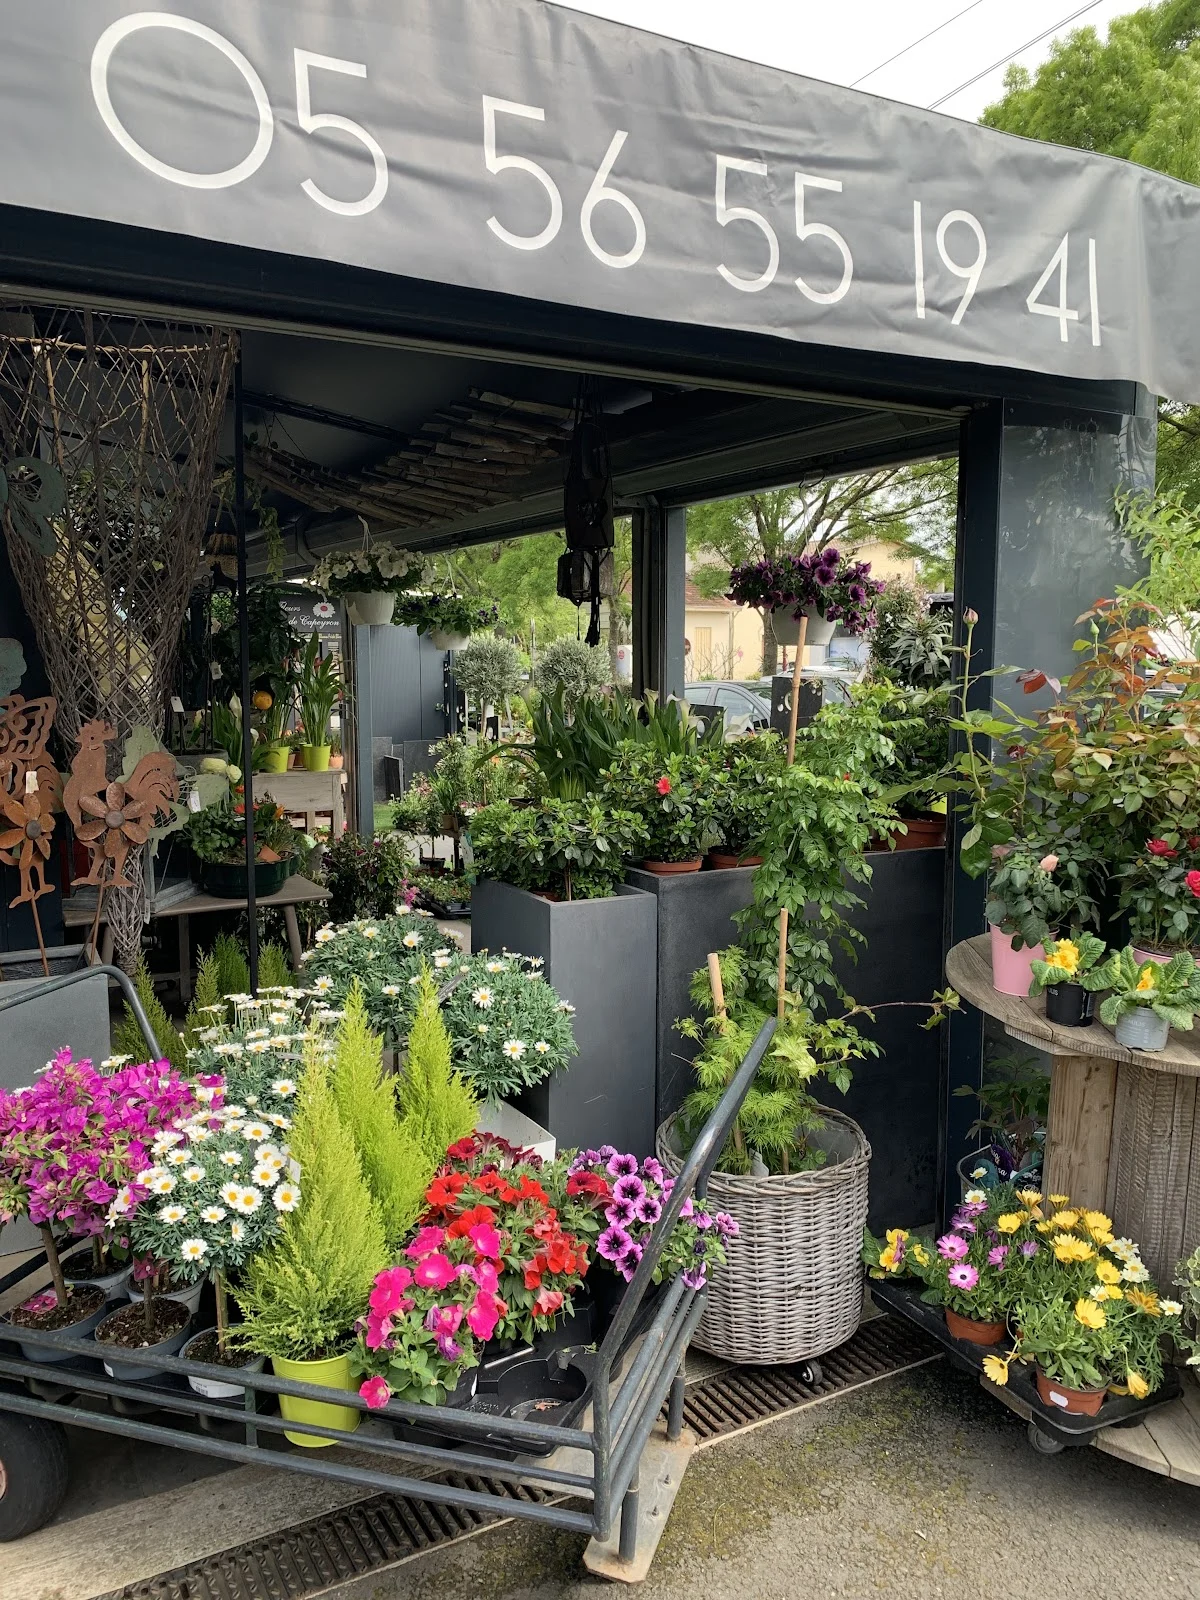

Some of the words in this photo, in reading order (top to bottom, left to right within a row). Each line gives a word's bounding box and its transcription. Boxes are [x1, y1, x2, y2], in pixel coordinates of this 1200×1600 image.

[481, 94, 647, 269] 56
[714, 153, 854, 305] 55
[912, 199, 987, 326] 19
[1025, 231, 1103, 347] 41
[288, 616, 298, 626] de
[299, 614, 340, 629] Capeyron
